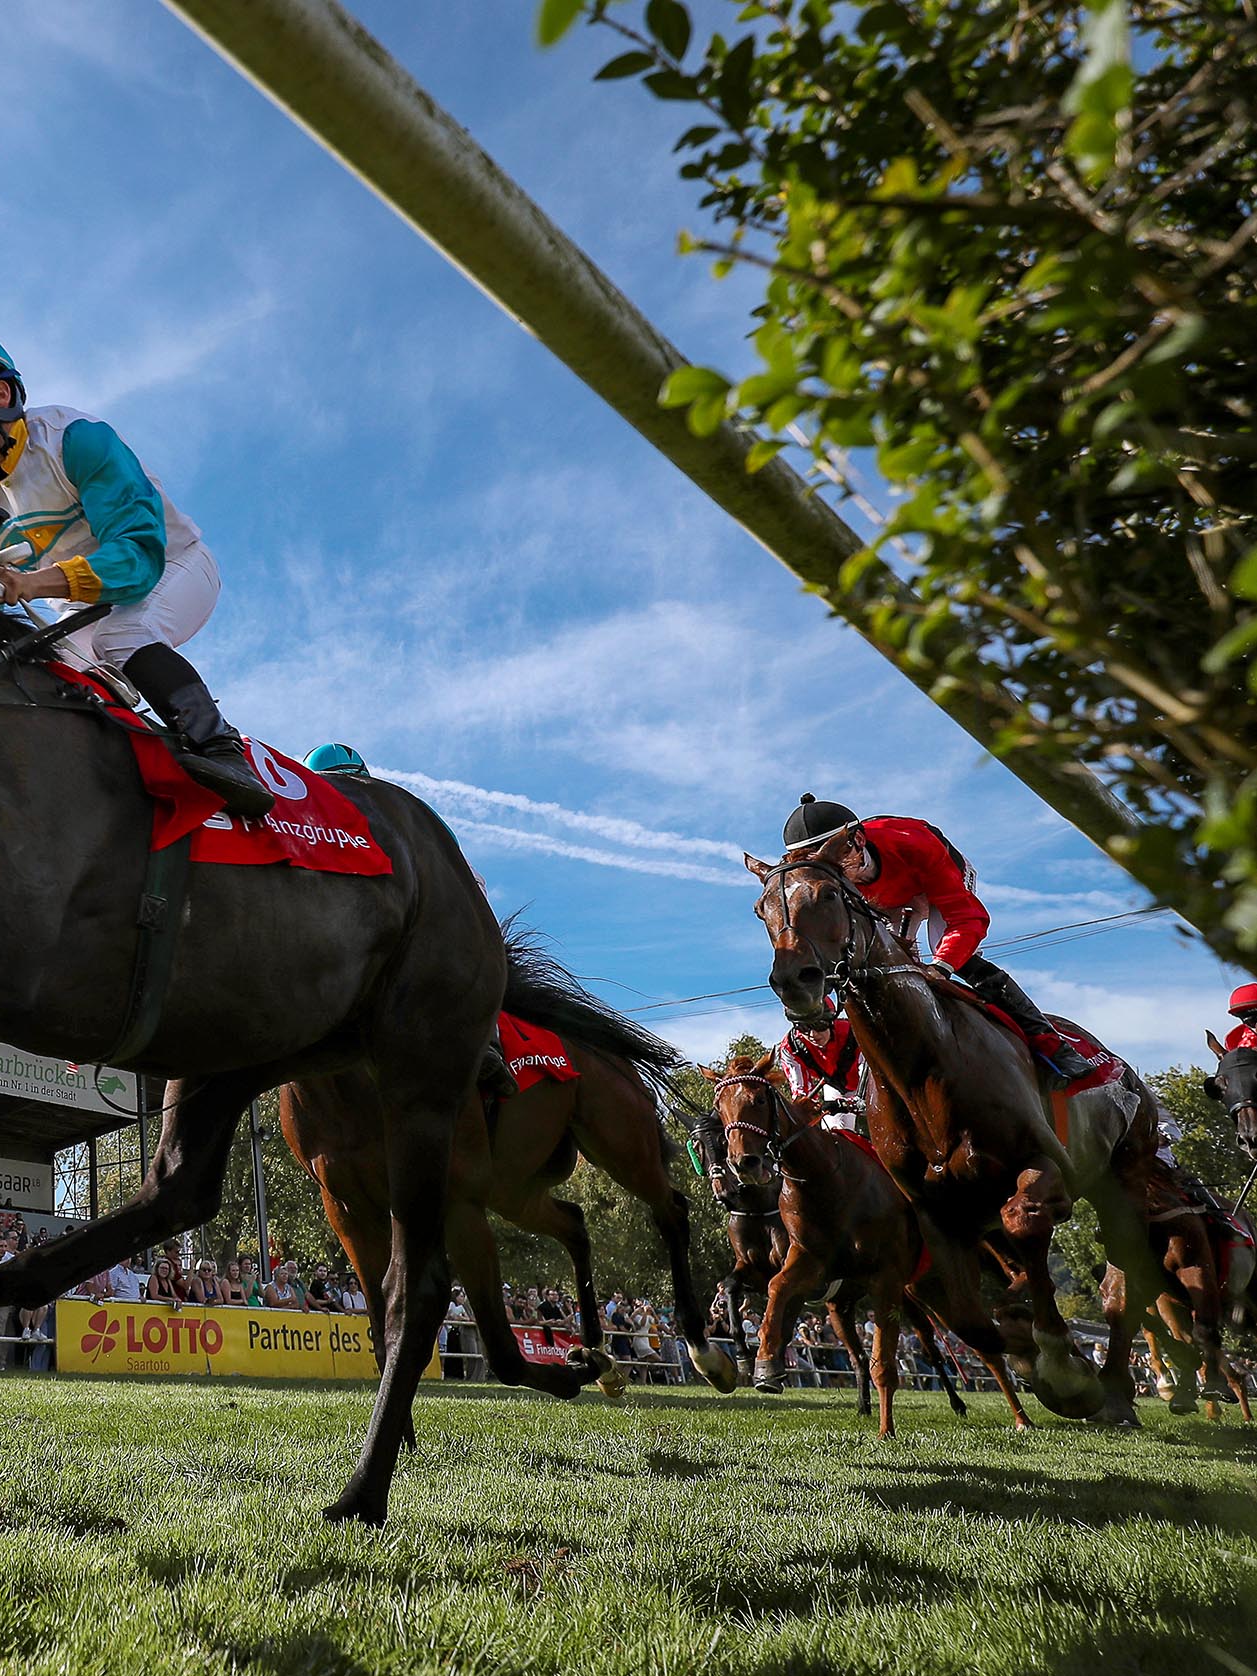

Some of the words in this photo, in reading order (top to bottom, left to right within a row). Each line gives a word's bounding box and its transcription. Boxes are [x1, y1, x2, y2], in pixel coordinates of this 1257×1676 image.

[11, 1079, 23, 1091] Nr.
[31, 1083, 39, 1093] in
[41, 1086, 55, 1097] der
[56, 1088, 77, 1101] Stadt
[126, 1315, 223, 1355] LOTTO
[248, 1320, 322, 1352] Partner
[329, 1323, 362, 1353] des
[127, 1357, 170, 1372] Saartoto
